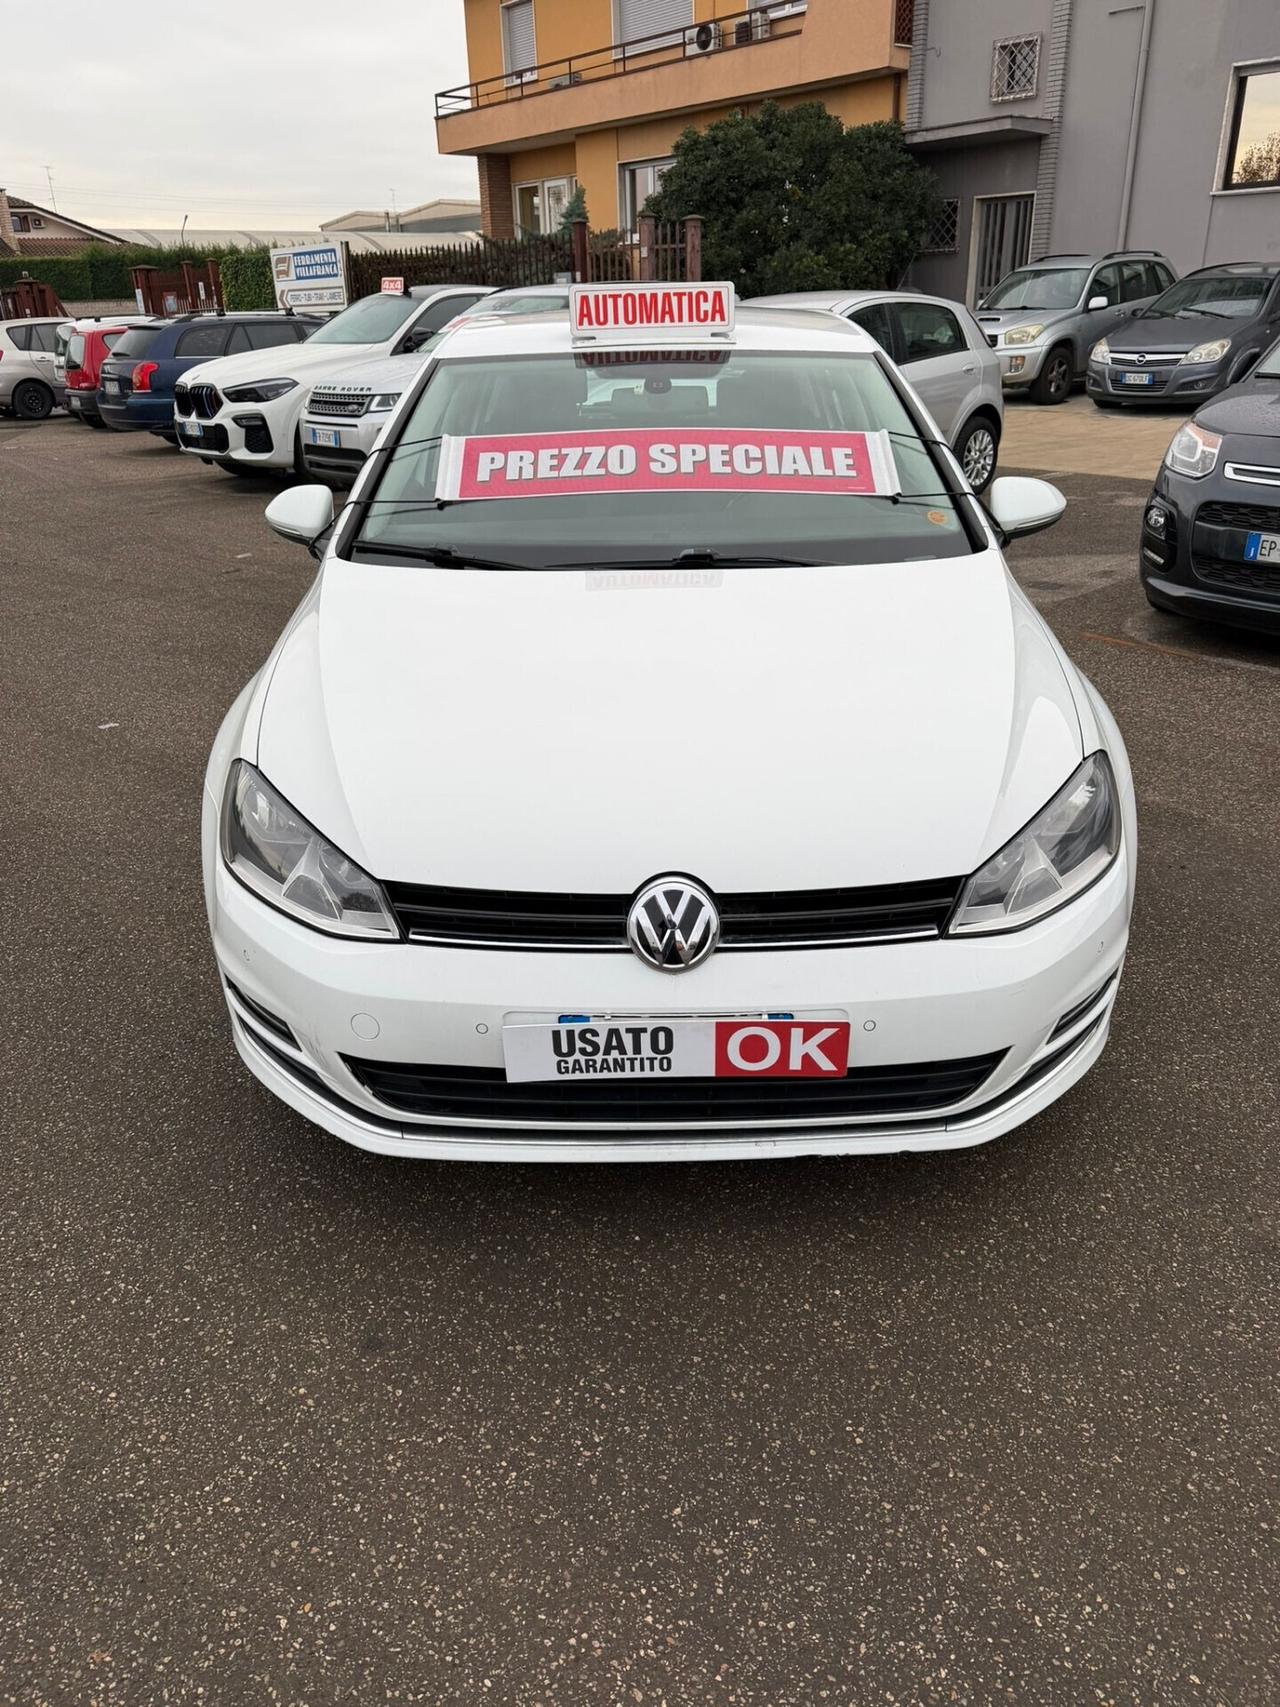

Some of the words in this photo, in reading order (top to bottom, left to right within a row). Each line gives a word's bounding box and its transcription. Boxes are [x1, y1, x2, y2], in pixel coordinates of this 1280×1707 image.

[294, 251, 335, 266] FERRAMENTA
[296, 263, 338, 277] VILLAFRANCA
[578, 290, 726, 327] AUTOMATICA
[476, 444, 637, 482] PREZZO
[649, 443, 857, 478] SPECIALE
[551, 1026, 674, 1058] USATO
[727, 1026, 841, 1072] OK
[556, 1056, 672, 1075] GARANTITO
